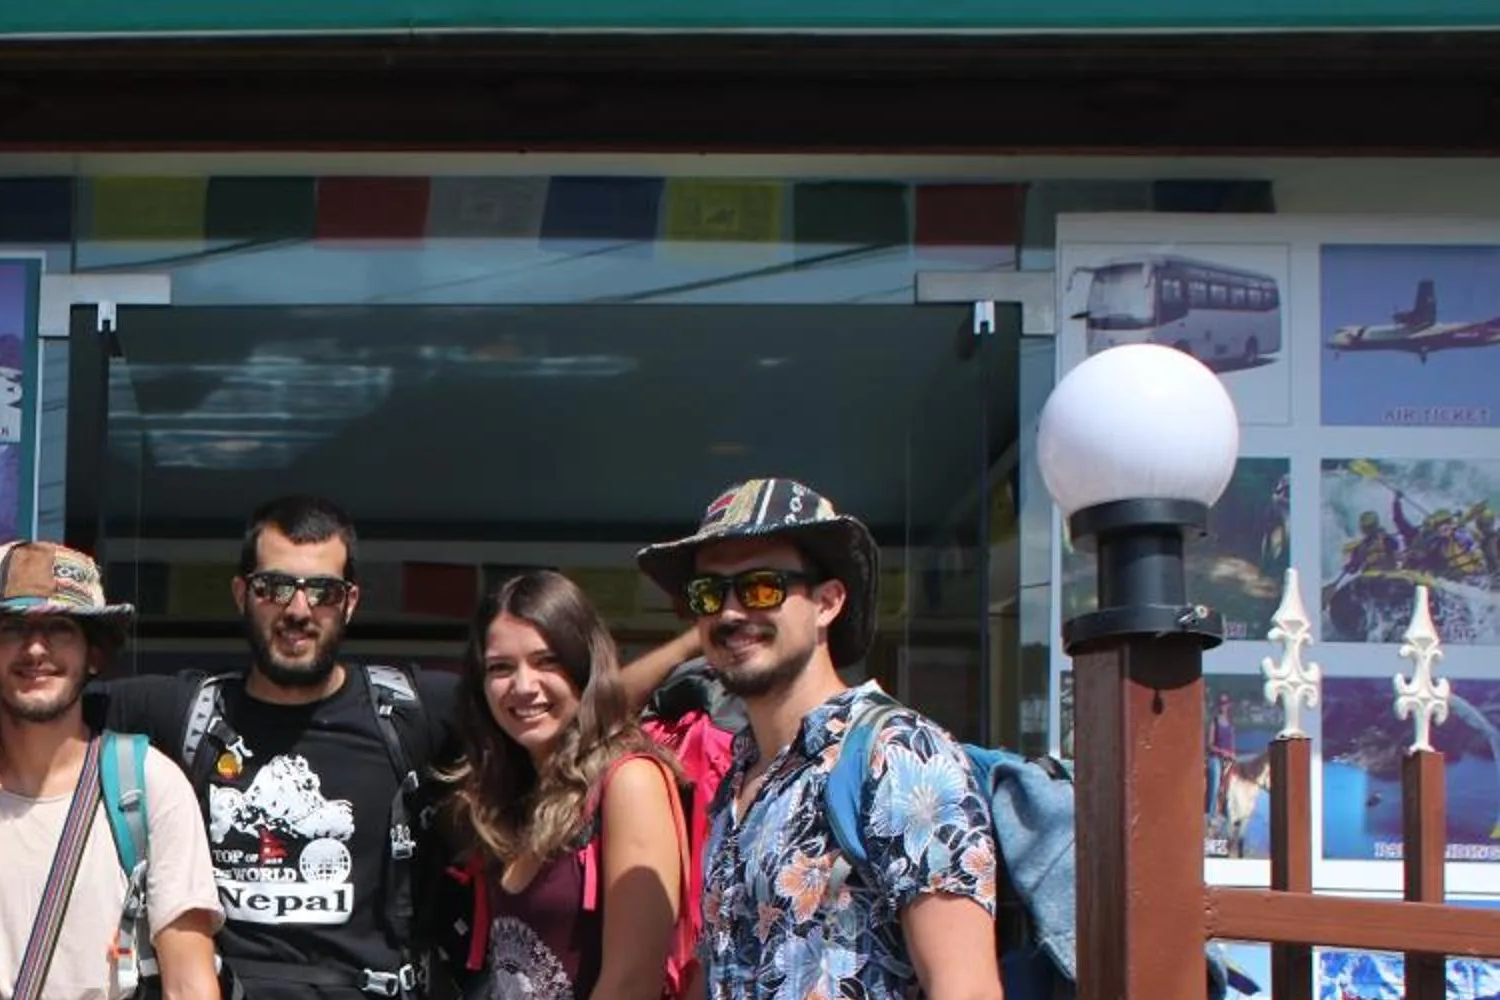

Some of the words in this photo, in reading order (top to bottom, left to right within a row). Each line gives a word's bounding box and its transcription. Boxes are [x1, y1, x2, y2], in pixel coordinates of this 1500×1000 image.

[213, 849, 244, 863] TOP
[232, 867, 297, 882] WORLD
[217, 885, 349, 917] Nepal
